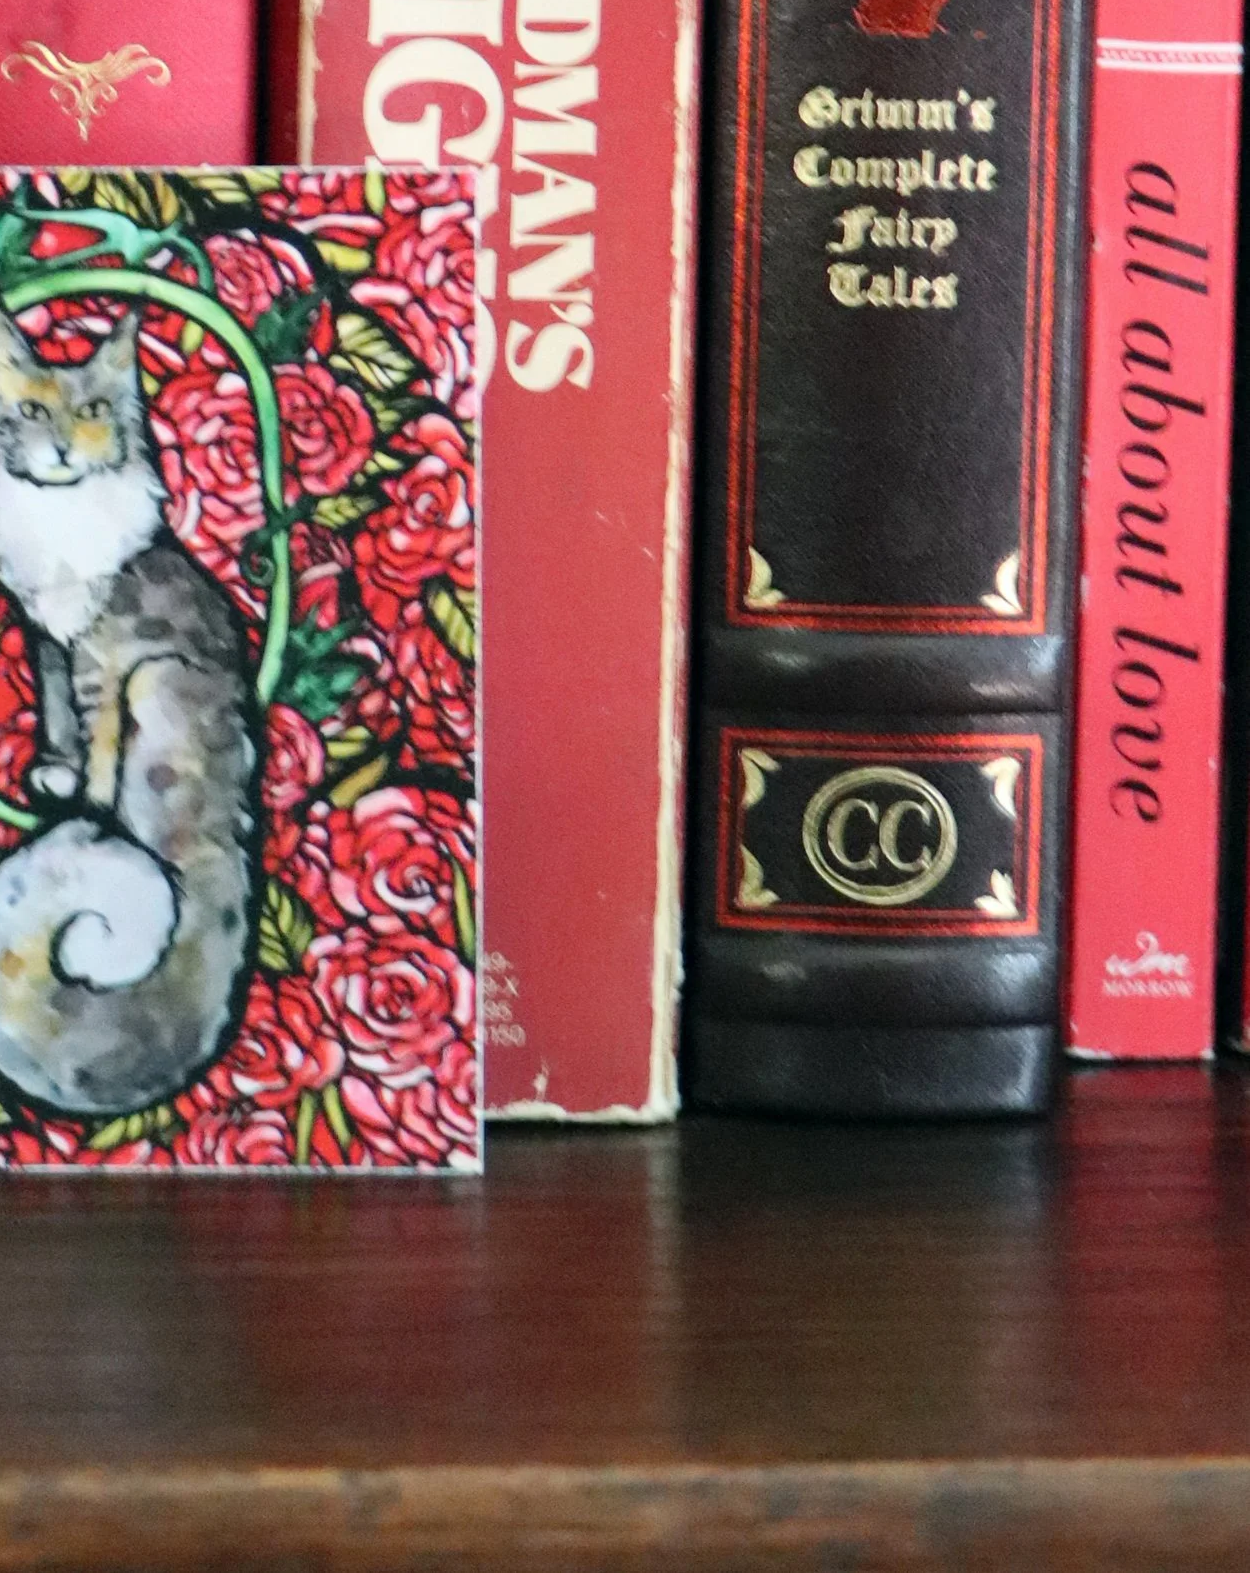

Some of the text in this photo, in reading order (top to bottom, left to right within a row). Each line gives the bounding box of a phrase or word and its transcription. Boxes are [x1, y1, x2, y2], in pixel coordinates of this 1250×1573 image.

[799, 87, 996, 132] Grimm's
[793, 146, 997, 196] Complete
[826, 206, 958, 256] Fairy
[827, 263, 959, 309] Tales
[1111, 162, 1209, 823] all about love
